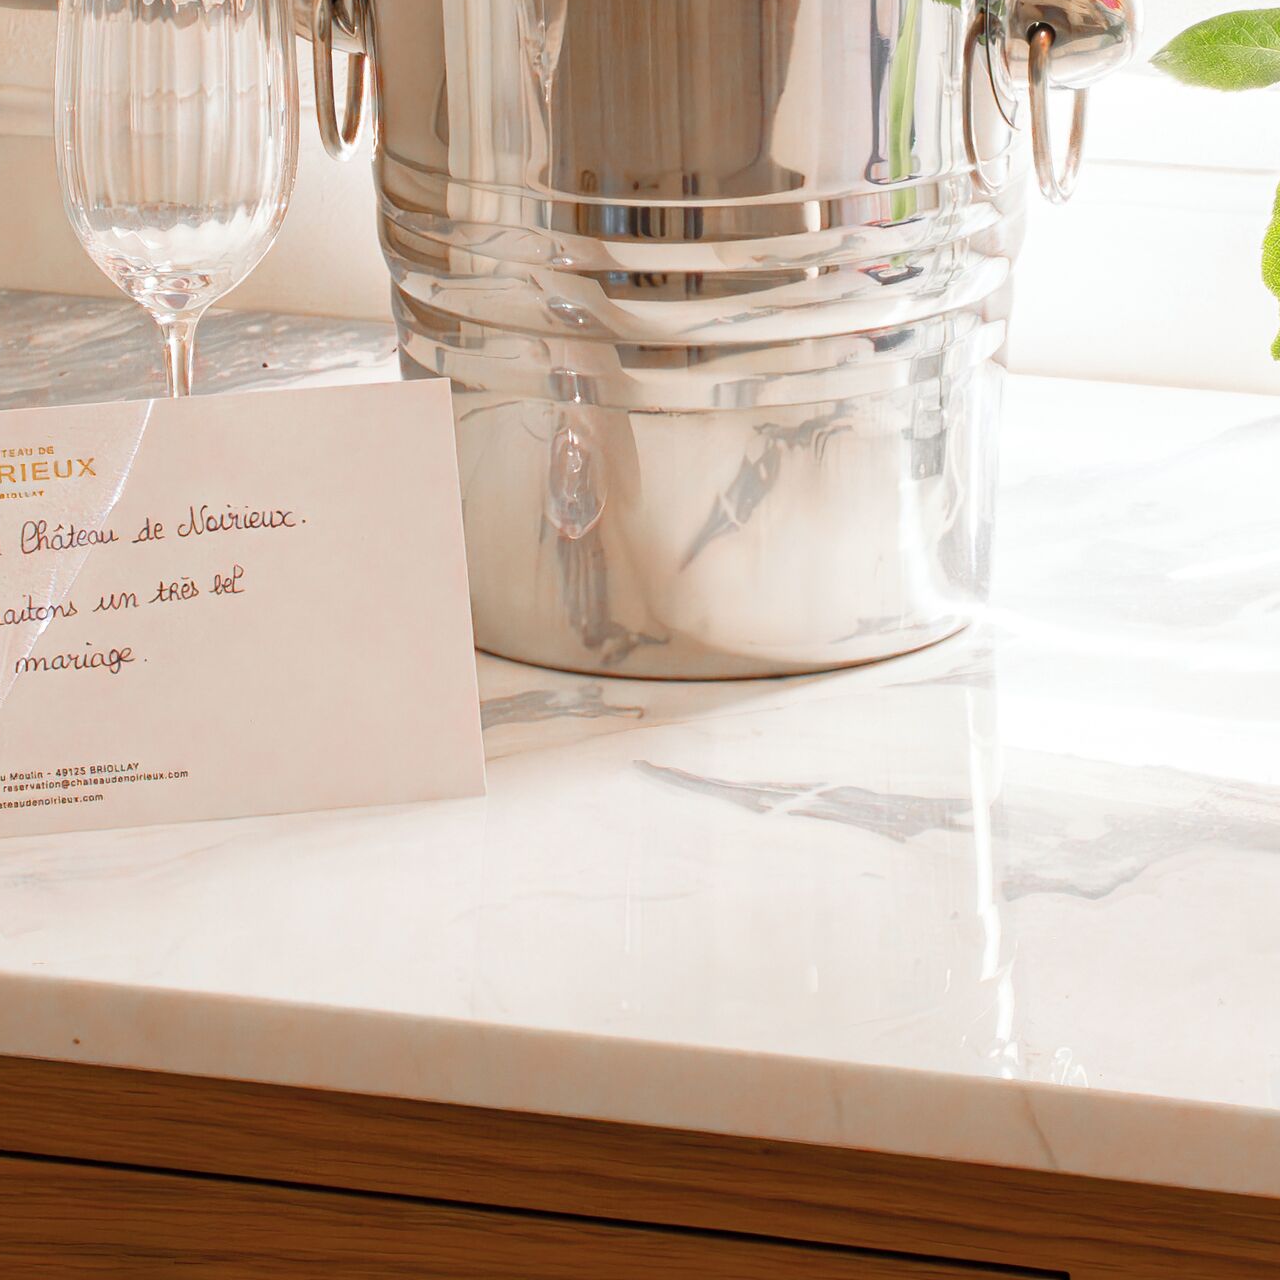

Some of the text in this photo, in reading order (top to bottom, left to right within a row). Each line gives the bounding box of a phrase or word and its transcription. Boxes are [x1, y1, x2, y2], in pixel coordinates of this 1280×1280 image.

[38, 446, 55, 455] DE
[20, 520, 119, 554] Château
[132, 517, 165, 543] de
[177, 504, 306, 537] Noirieux.
[92, 591, 139, 613] un
[148, 577, 200, 604] très
[209, 564, 245, 595] bel
[9, 771, 44, 781] Moulin
[55, 766, 86, 777] 49125
[90, 762, 139, 775] BRIOLLAY
